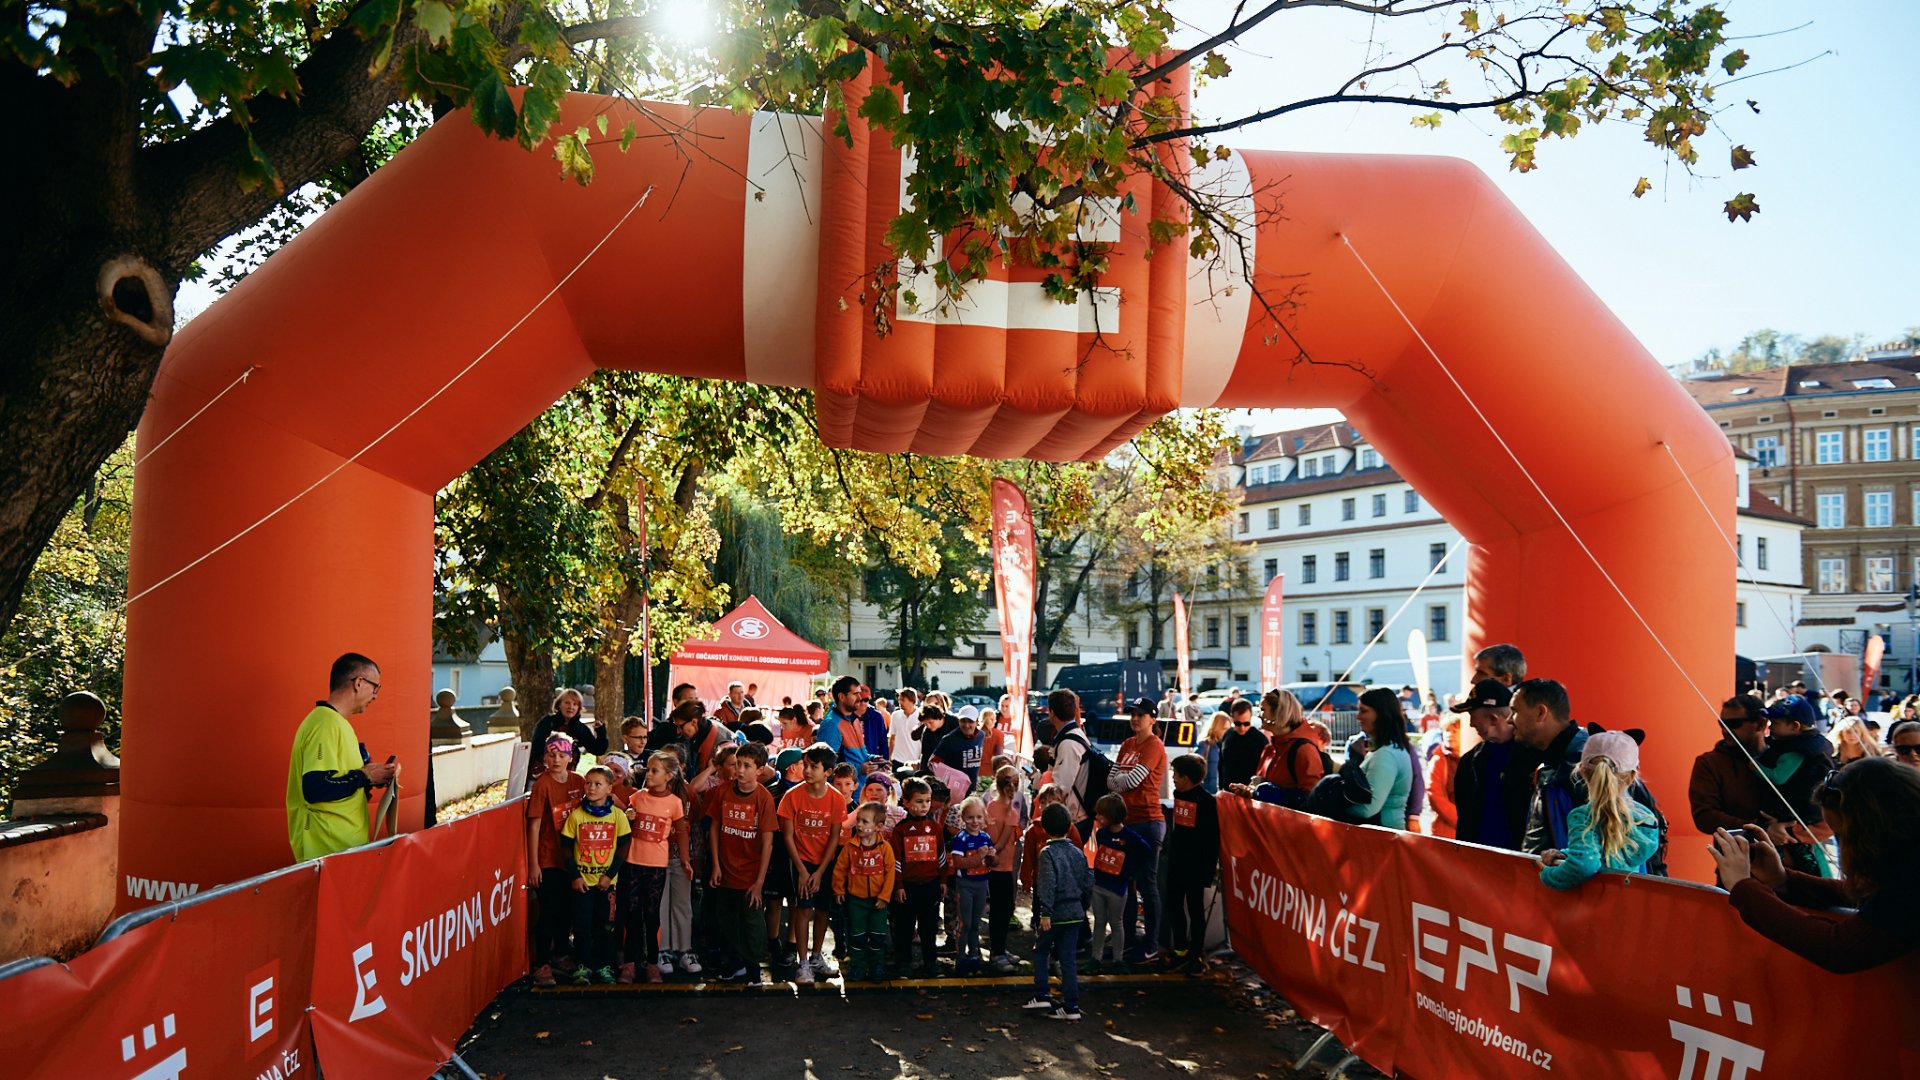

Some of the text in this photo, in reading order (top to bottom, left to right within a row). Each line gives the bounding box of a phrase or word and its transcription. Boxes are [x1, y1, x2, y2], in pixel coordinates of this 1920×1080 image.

[1178, 722, 1194, 745] 0
[729, 809, 746, 820] 528
[804, 818, 823, 827] 500
[400, 891, 484, 987] SKUPINA
[489, 868, 515, 927] ČEZ
[1248, 869, 1327, 948] SKUPINA
[1329, 891, 1387, 973] ČEZ
[1411, 901, 1553, 1014] EPP
[250, 976, 274, 1043] E
[1416, 991, 1553, 1071] pomahejpohybem.cz
[281, 1048, 301, 1077] ČEZ
